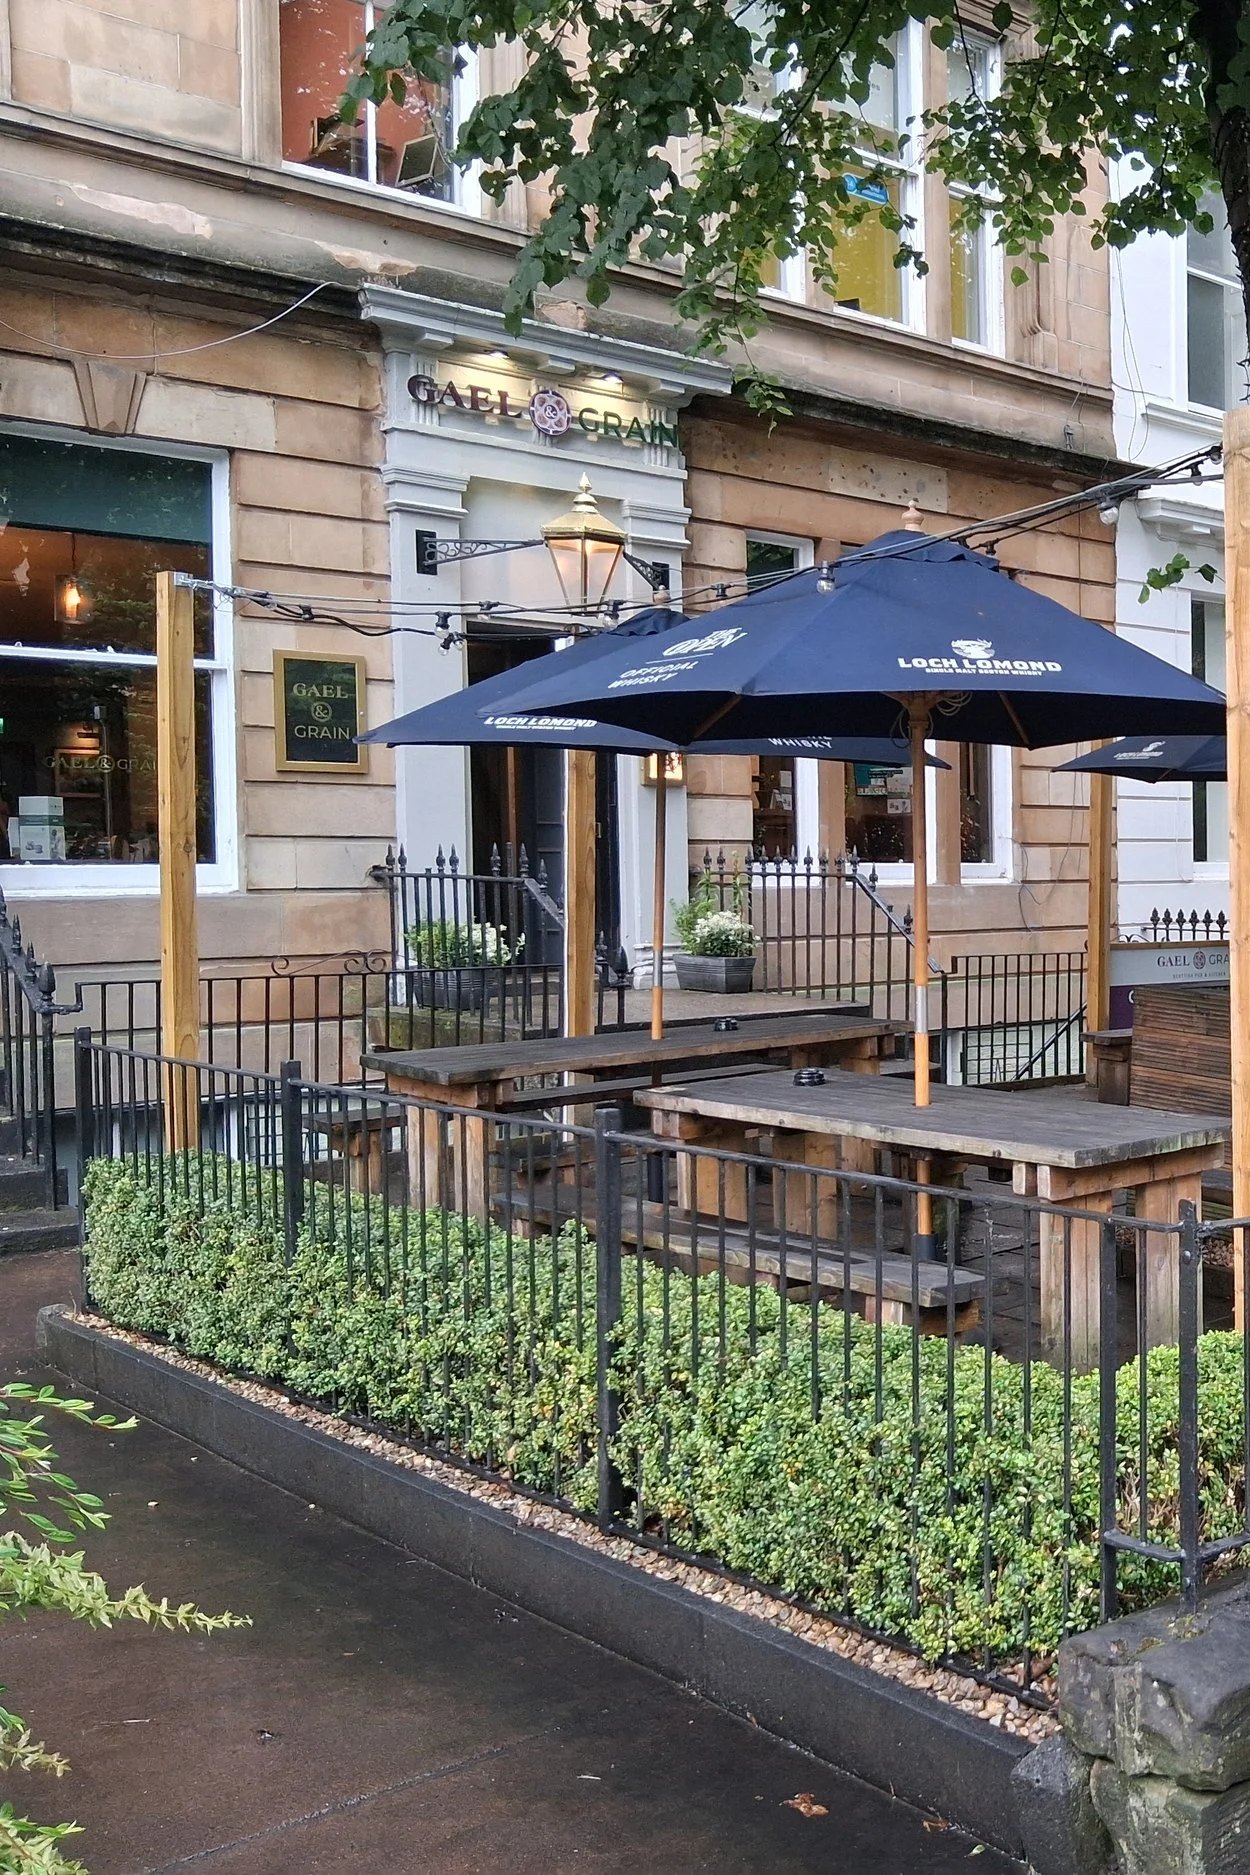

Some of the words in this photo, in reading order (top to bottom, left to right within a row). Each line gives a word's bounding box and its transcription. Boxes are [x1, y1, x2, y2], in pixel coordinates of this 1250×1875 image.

[407, 374, 522, 418] GAEL
[578, 407, 679, 448] GRAIN
[897, 657, 959, 669] LOCH
[962, 658, 1063, 672] LOMOND
[292, 682, 349, 699] GAEL
[484, 716, 528, 725] LOCH
[527, 716, 598, 727] LOMOND
[294, 725, 350, 740] GRAIN
[767, 738, 832, 748] WHISKY
[1157, 956, 1190, 967] GAEL
[1209, 954, 1229, 965] GRA
